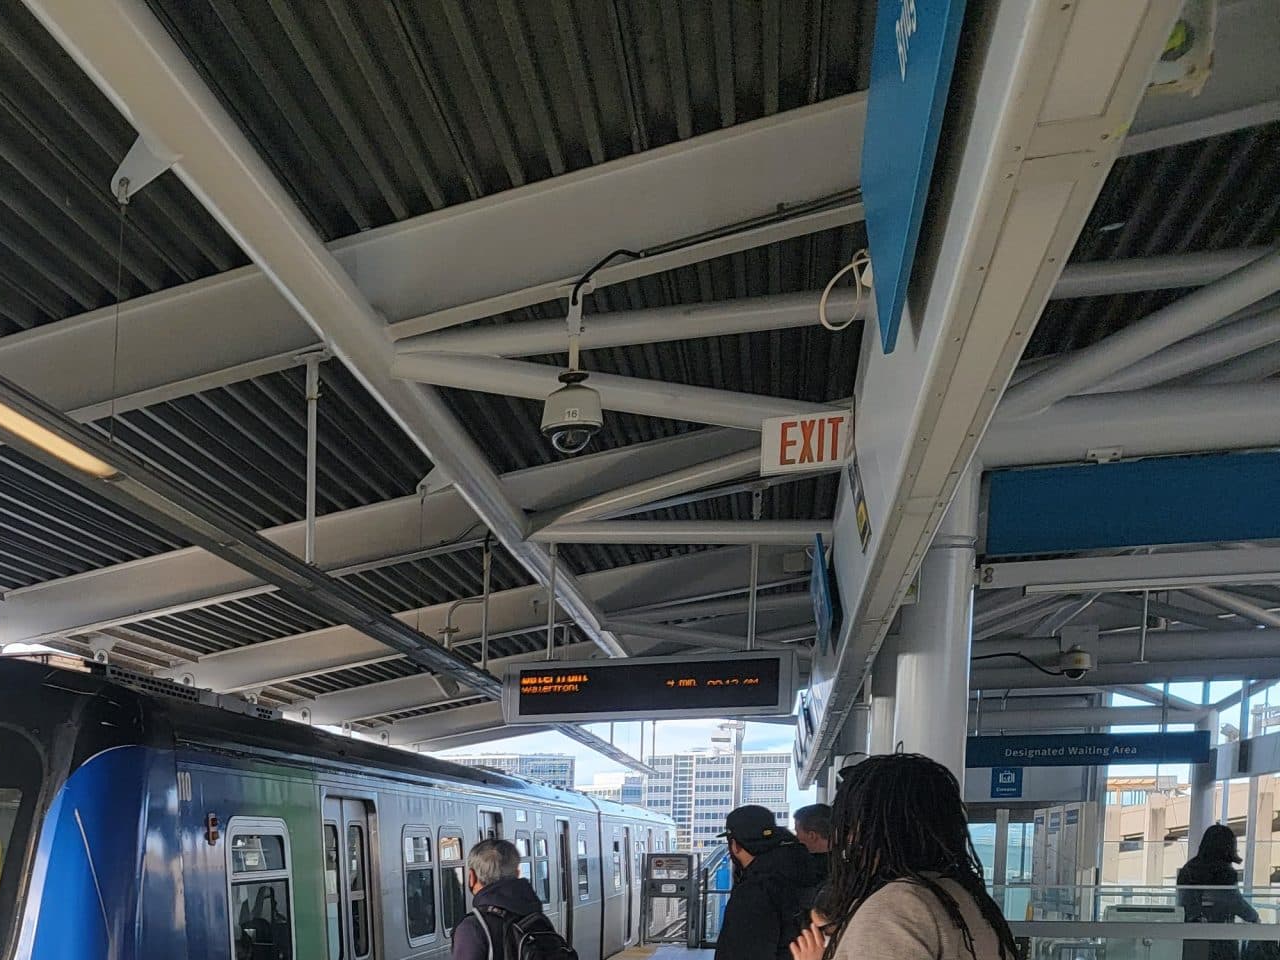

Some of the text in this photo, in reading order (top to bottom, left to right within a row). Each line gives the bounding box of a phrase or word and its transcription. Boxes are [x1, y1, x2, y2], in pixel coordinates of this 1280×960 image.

[780, 416, 844, 465] EXIT
[1004, 745, 1137, 758] Designated Waiting Area
[177, 771, 192, 802] 110
